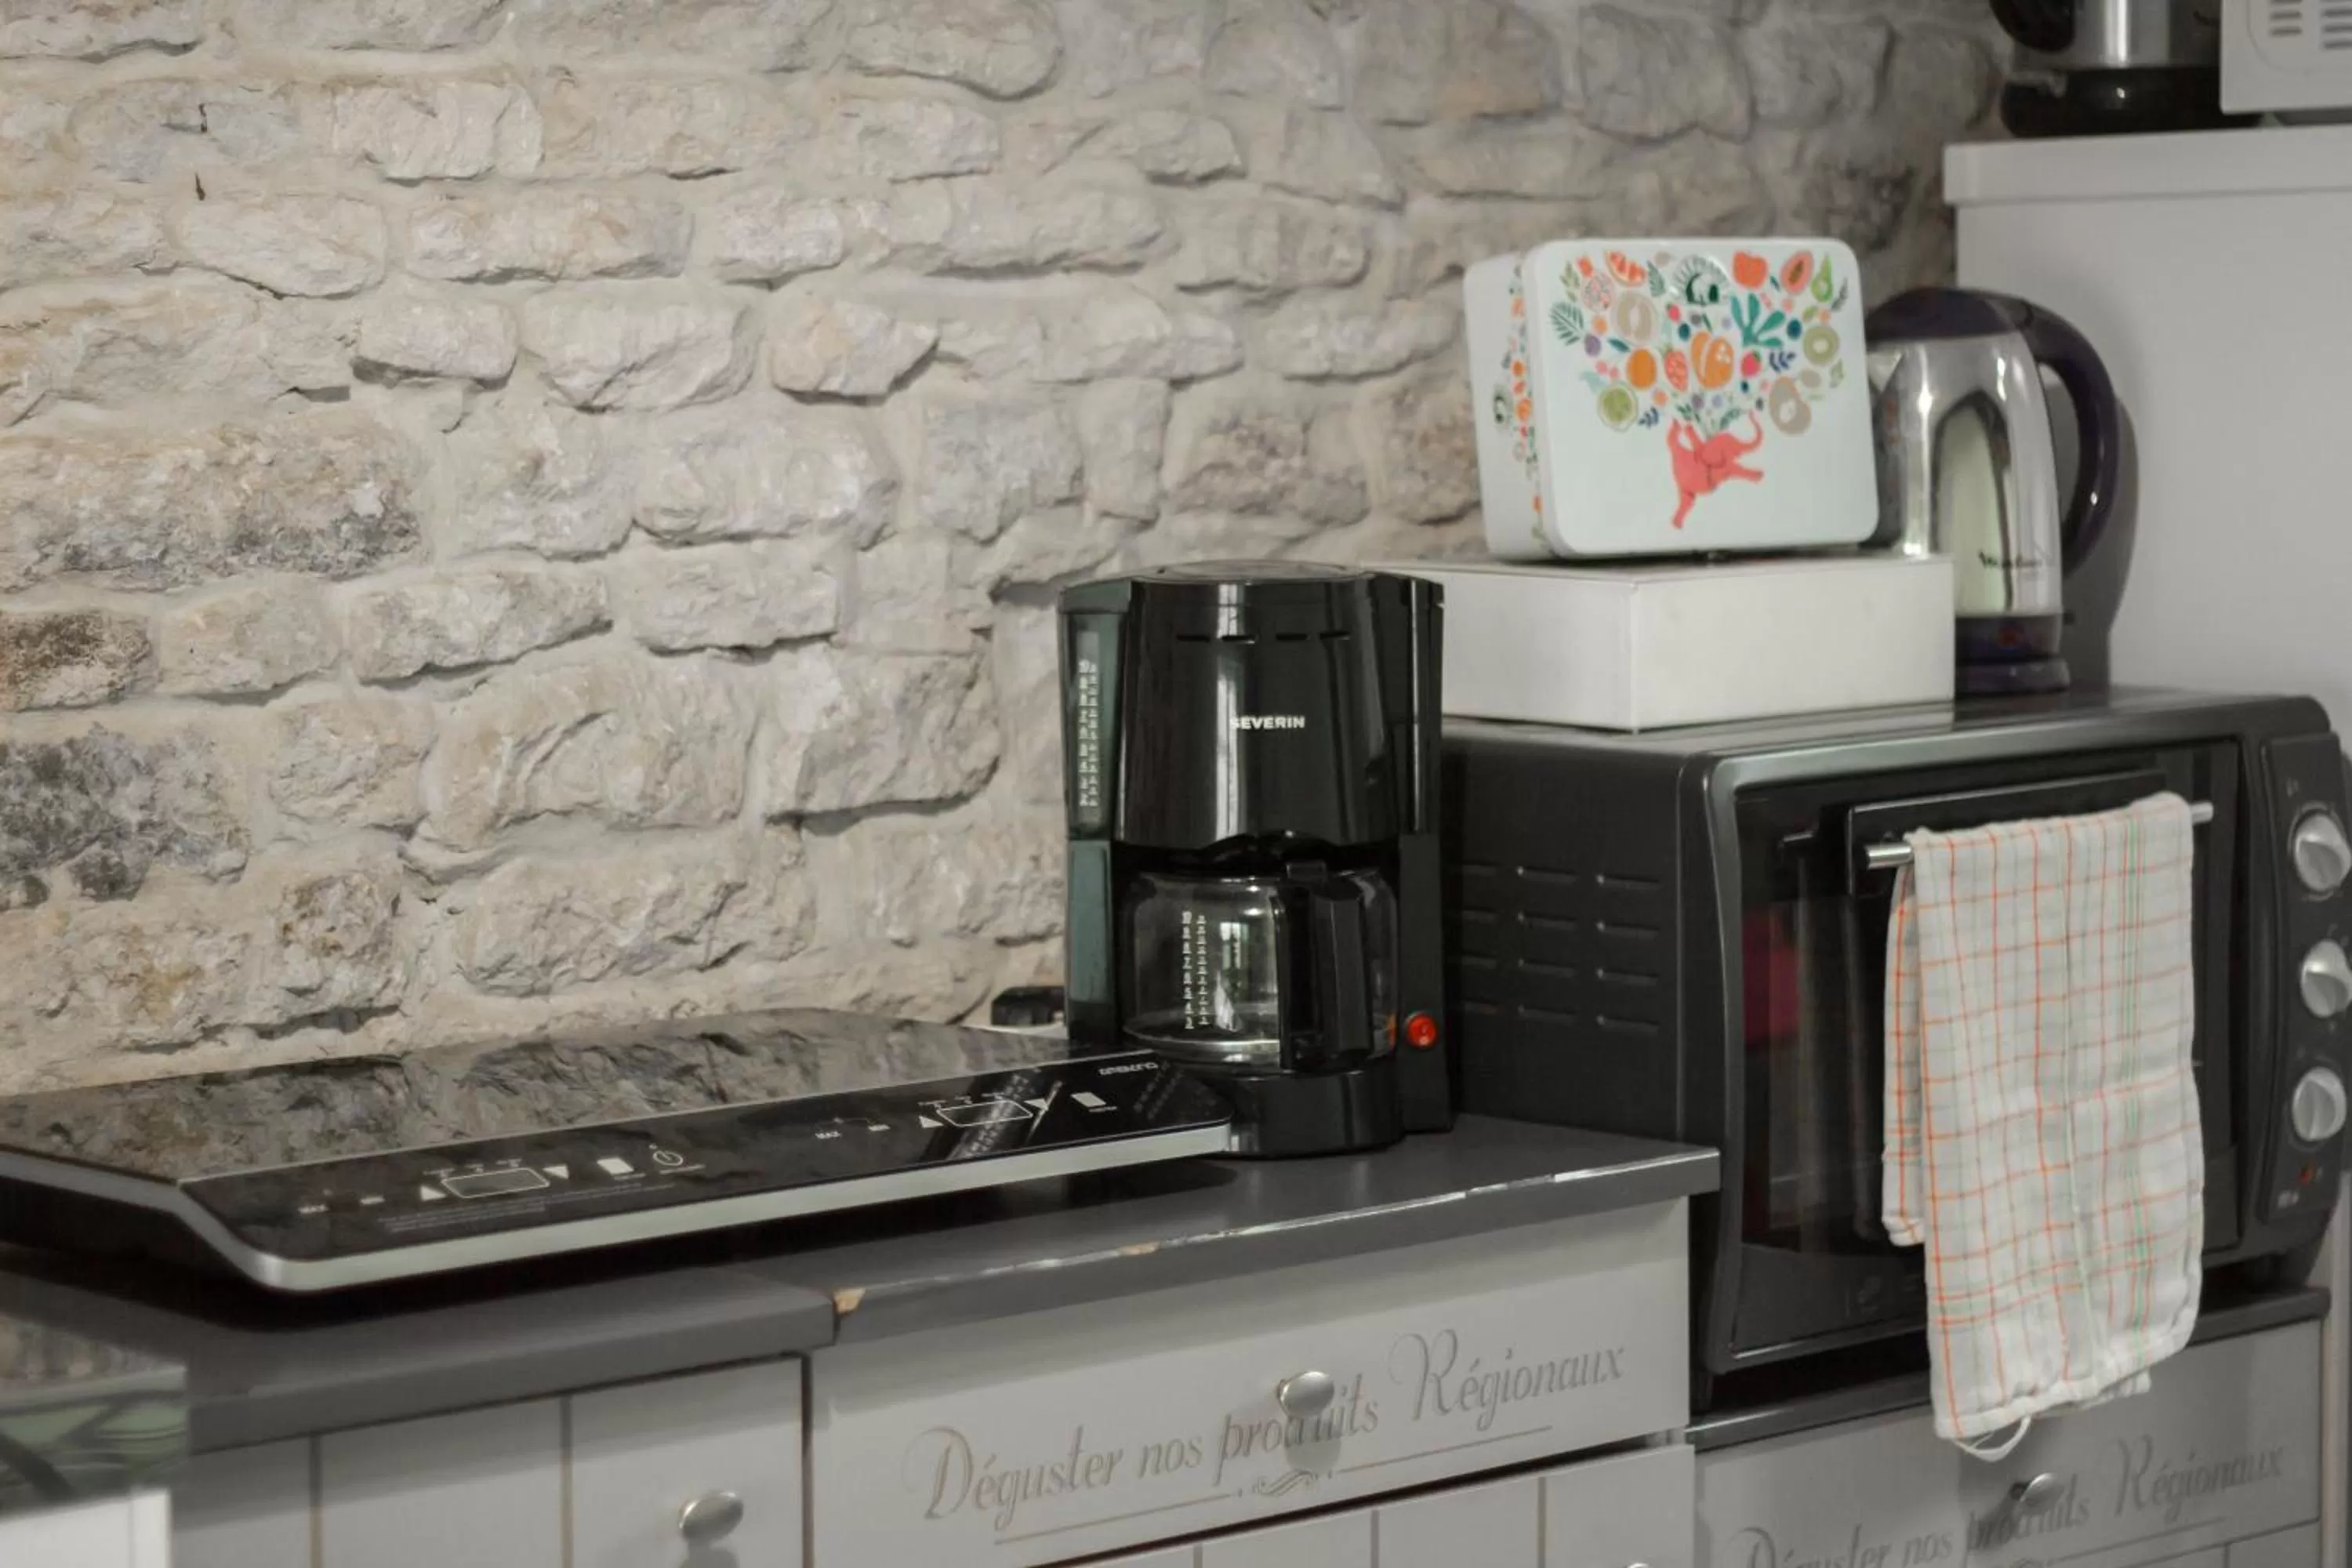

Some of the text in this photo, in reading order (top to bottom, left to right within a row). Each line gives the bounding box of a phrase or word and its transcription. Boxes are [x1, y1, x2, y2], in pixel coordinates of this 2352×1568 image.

[902, 1425, 1124, 1531] Déguster
[1138, 1436, 1203, 1480] nos
[1388, 1329, 1625, 1432] Régionaux
